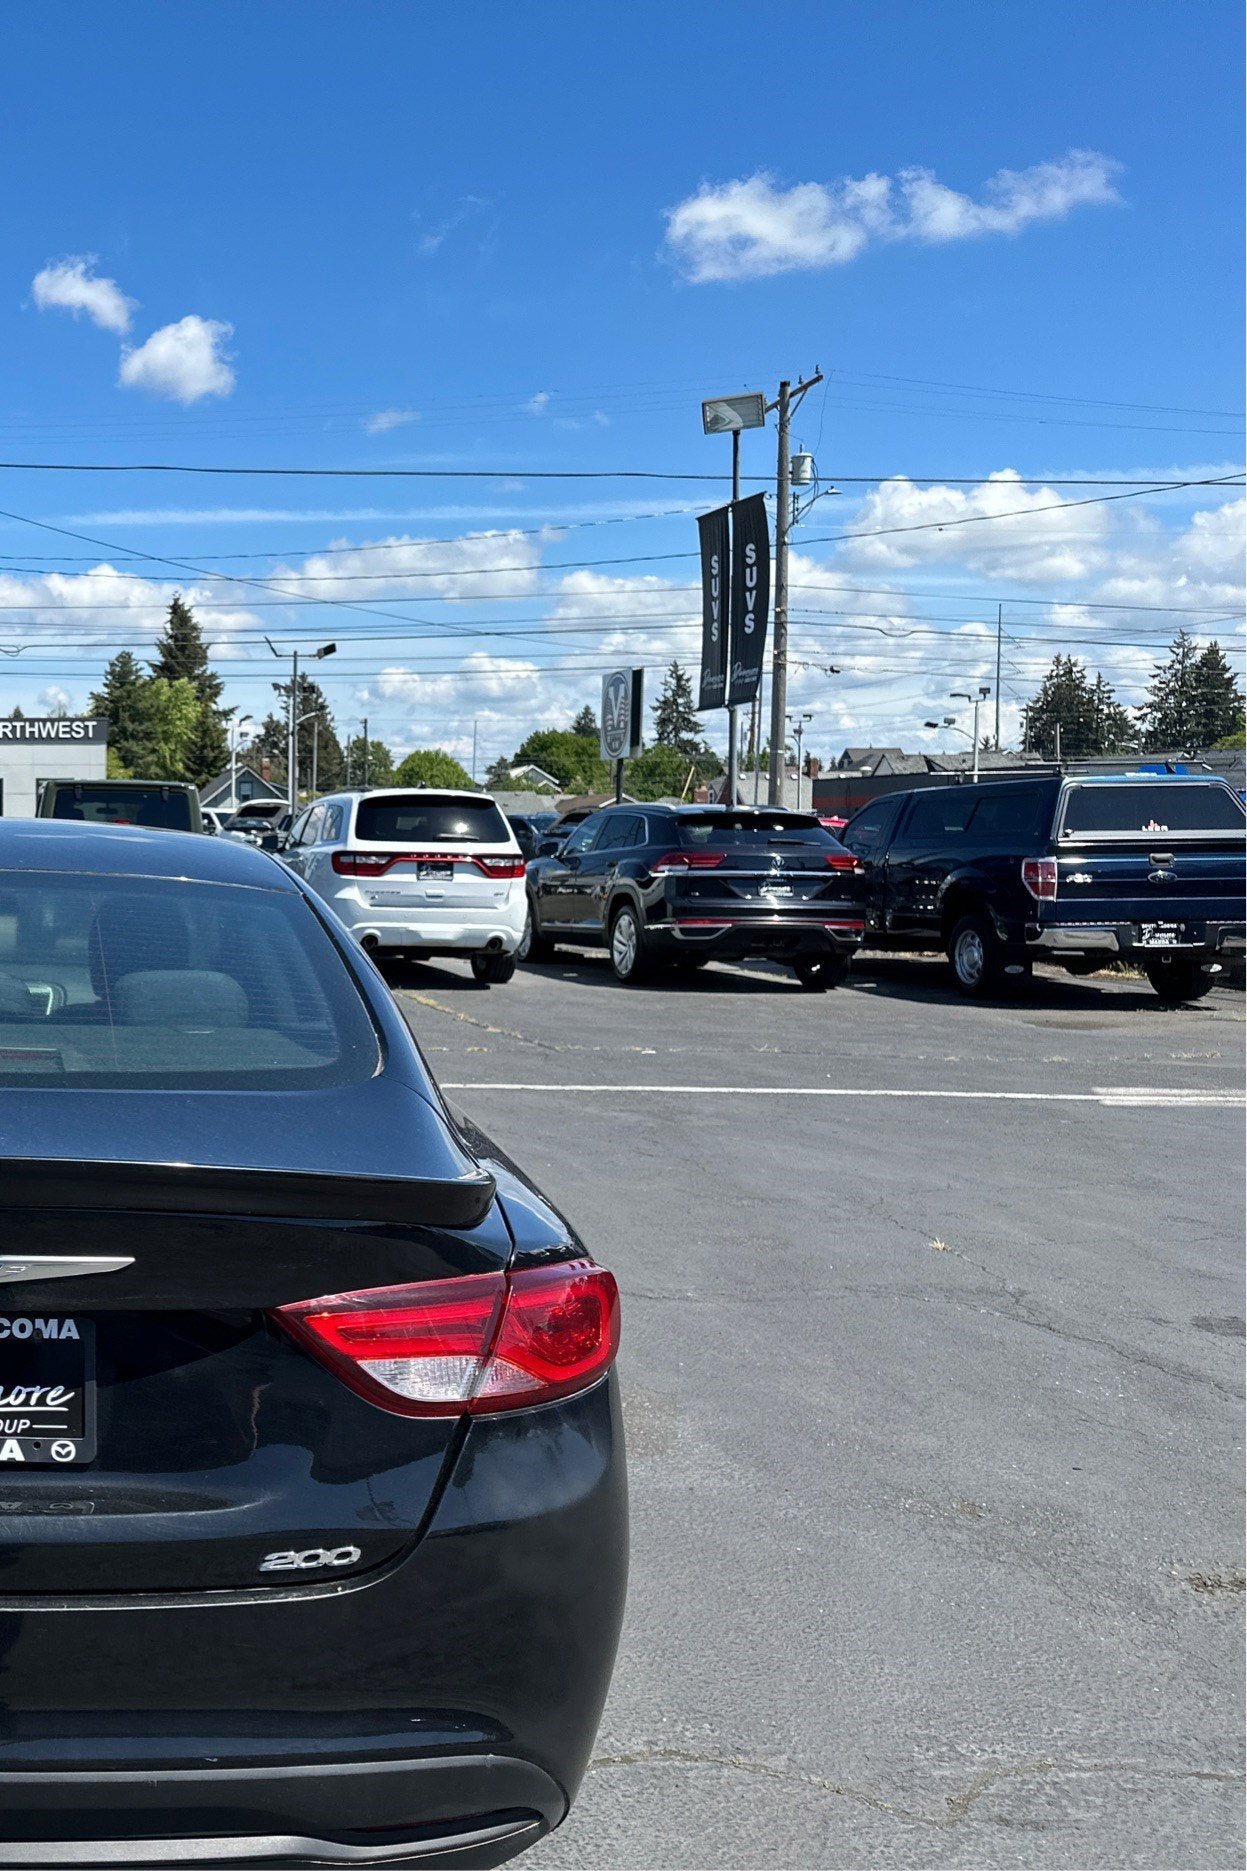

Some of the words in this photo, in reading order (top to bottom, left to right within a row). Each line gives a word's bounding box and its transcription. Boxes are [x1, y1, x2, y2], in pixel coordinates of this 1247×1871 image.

[710, 554, 720, 643] SUVS
[743, 542, 757, 635] SUVS
[259, 1545, 362, 1572] 200
